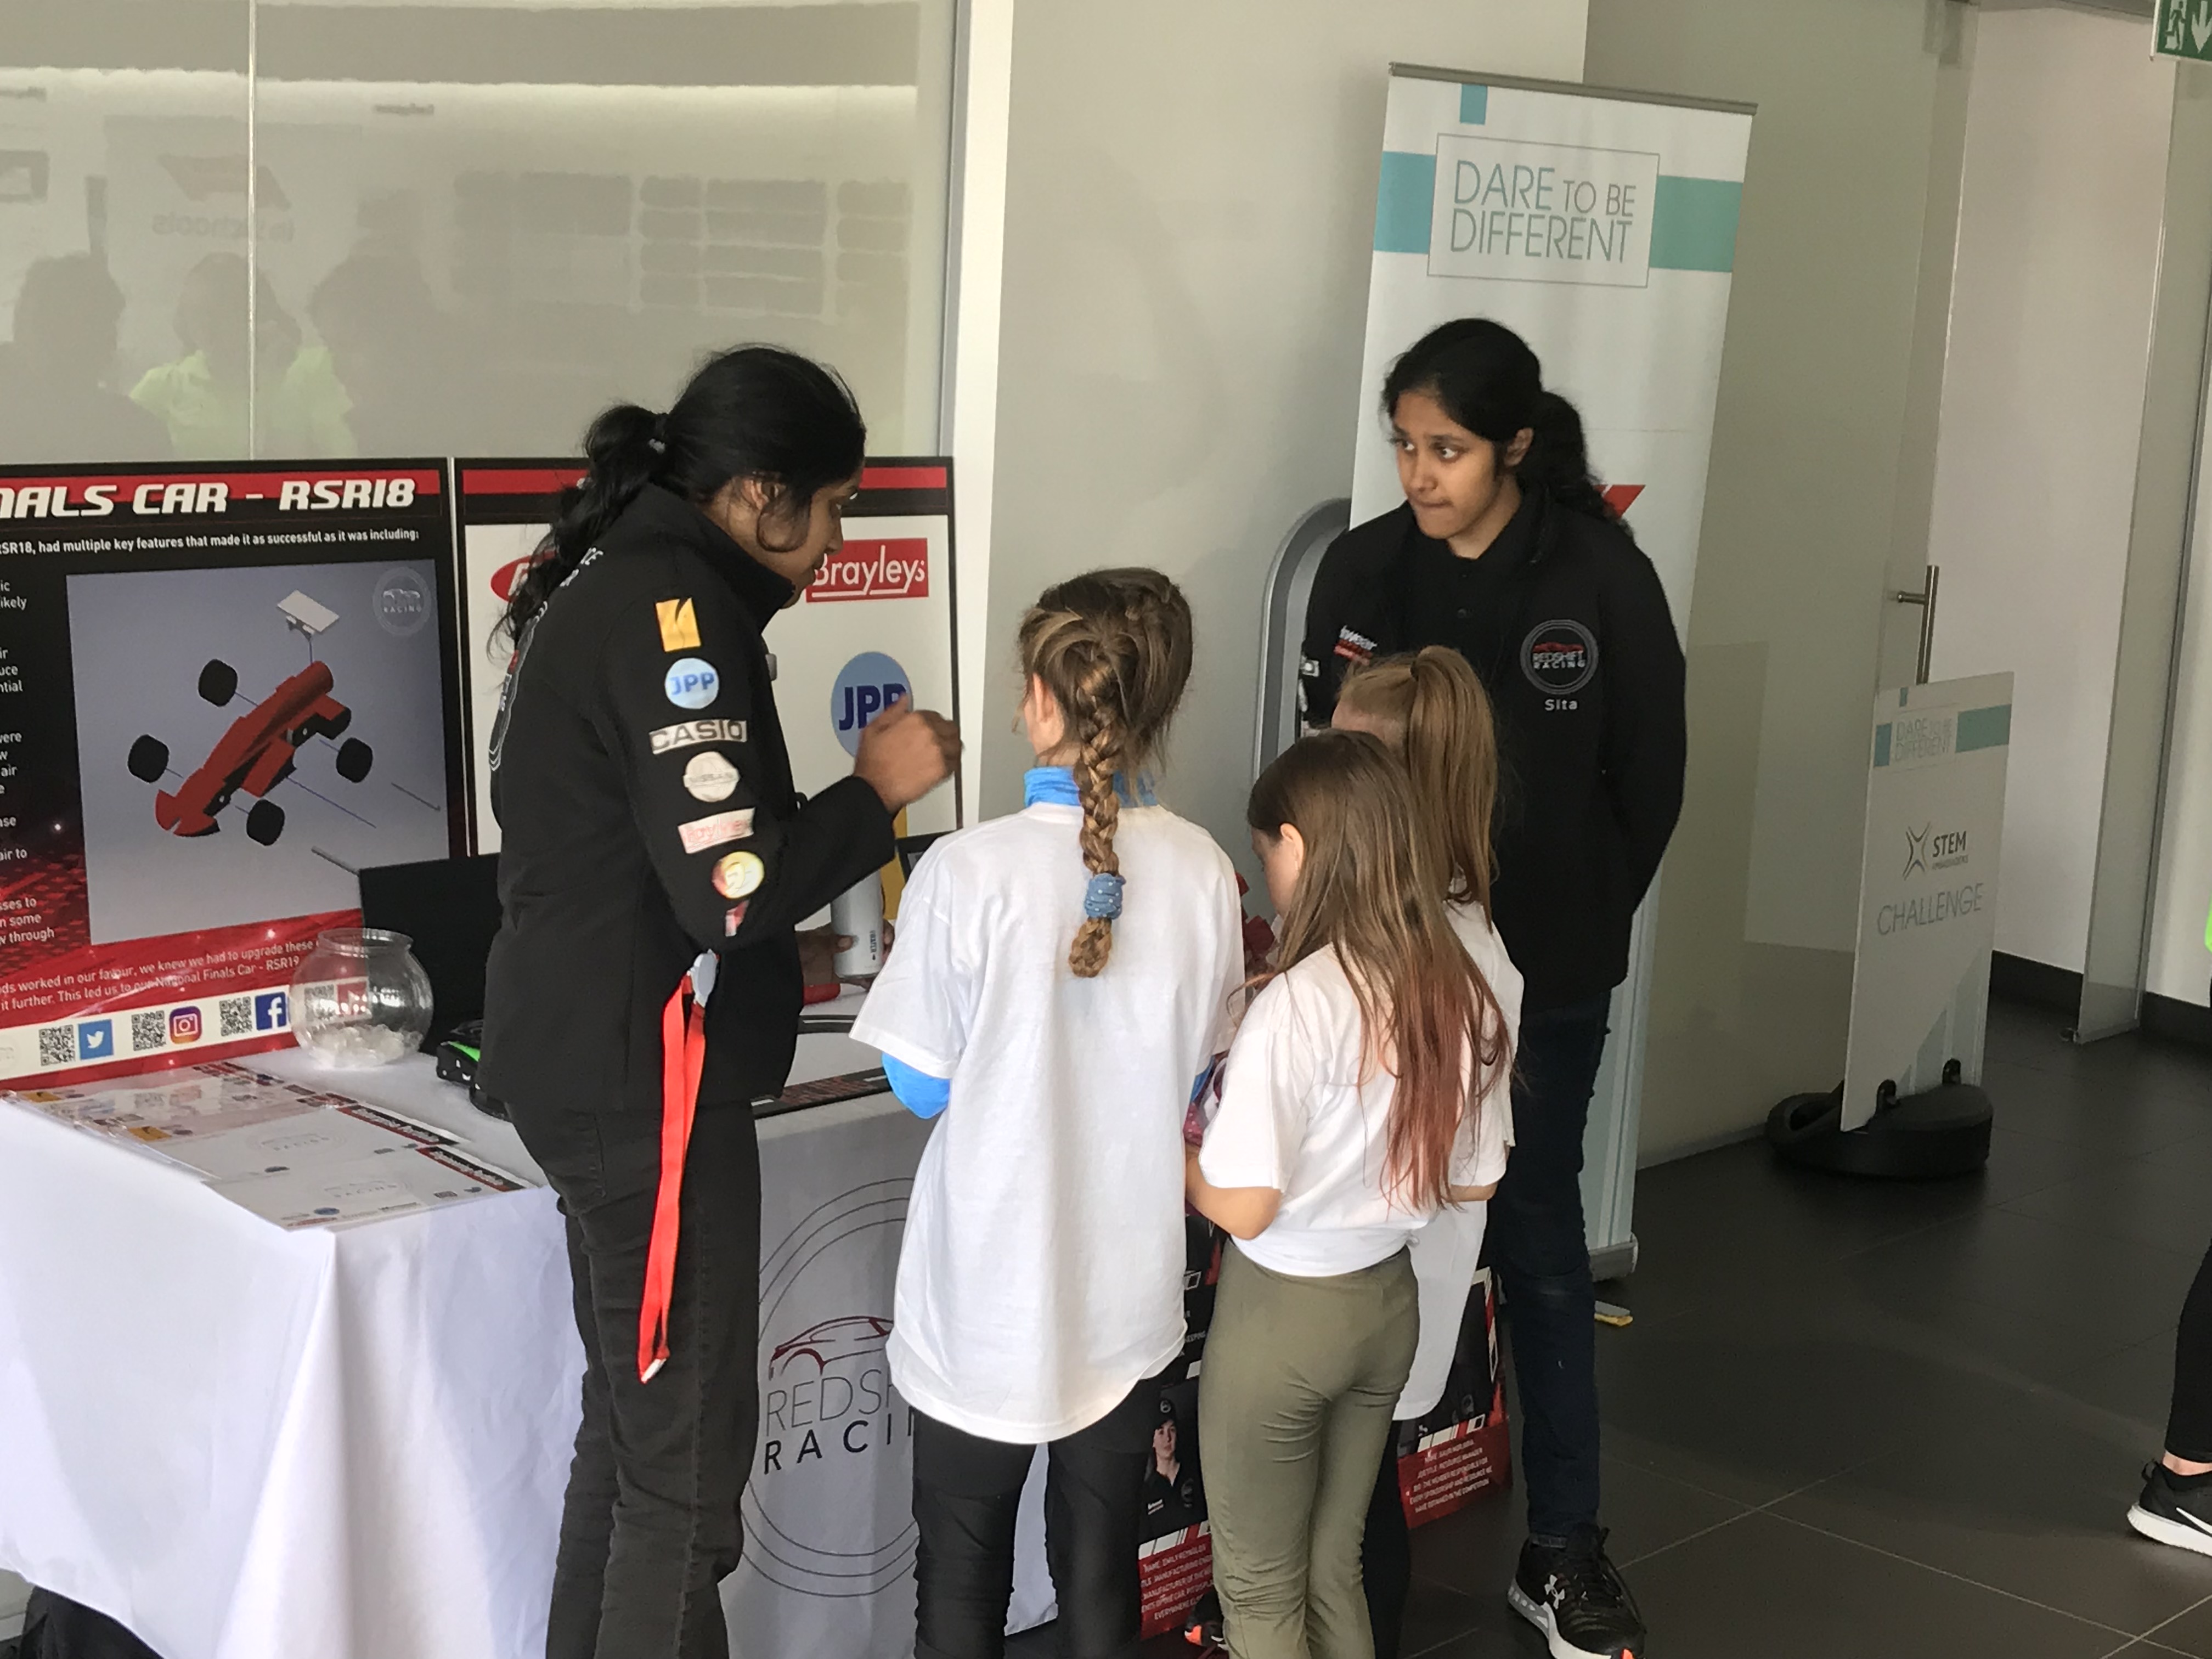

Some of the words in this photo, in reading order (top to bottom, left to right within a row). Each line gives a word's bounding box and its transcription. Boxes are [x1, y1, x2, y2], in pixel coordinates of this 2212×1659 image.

[1453, 160, 1555, 211] DARE
[1563, 179, 1596, 214] TO
[1605, 183, 1637, 217] BE
[1449, 208, 1633, 263] DIFFERENT
[133, 483, 229, 515] CAR
[279, 478, 415, 510] RSR18
[39, 539, 60, 552] had
[63, 537, 111, 554] multiple
[114, 538, 134, 552] key
[137, 535, 184, 550] features
[186, 535, 208, 547] that
[210, 534, 240, 546] made
[242, 533, 251, 545] it
[252, 534, 265, 545] as
[267, 531, 323, 545] successful
[324, 532, 336, 542] as
[338, 529, 346, 542] it
[347, 531, 368, 542] was
[370, 527, 420, 541] including:
[1533, 659, 1586, 669] RACING
[670, 672, 715, 696] JPP
[1544, 698, 1578, 712] Sita
[649, 720, 743, 750] CASIO
[15, 848, 27, 859] to
[1932, 831, 1967, 857] STEM
[25, 897, 37, 908] to
[1876, 882, 1984, 936] CHALLENGE
[9, 913, 42, 926] some
[9, 927, 55, 942] through
[18, 975, 60, 992] worked
[64, 973, 75, 985] in
[77, 971, 97, 983] our
[139, 963, 155, 974] we
[157, 958, 187, 971] knew
[188, 955, 204, 967] we
[206, 950, 226, 963] had
[227, 950, 239, 962] to
[241, 944, 283, 960] upgrade
[285, 940, 313, 953] these
[1, 1001, 9, 1012] it
[12, 993, 55, 1009] further.
[57, 988, 82, 1003] This
[84, 986, 102, 998] led
[104, 985, 117, 996] us
[120, 984, 132, 994] to
[203, 966, 236, 982] Finals
[237, 964, 257, 976] Car
[266, 956, 300, 972] RSR19
